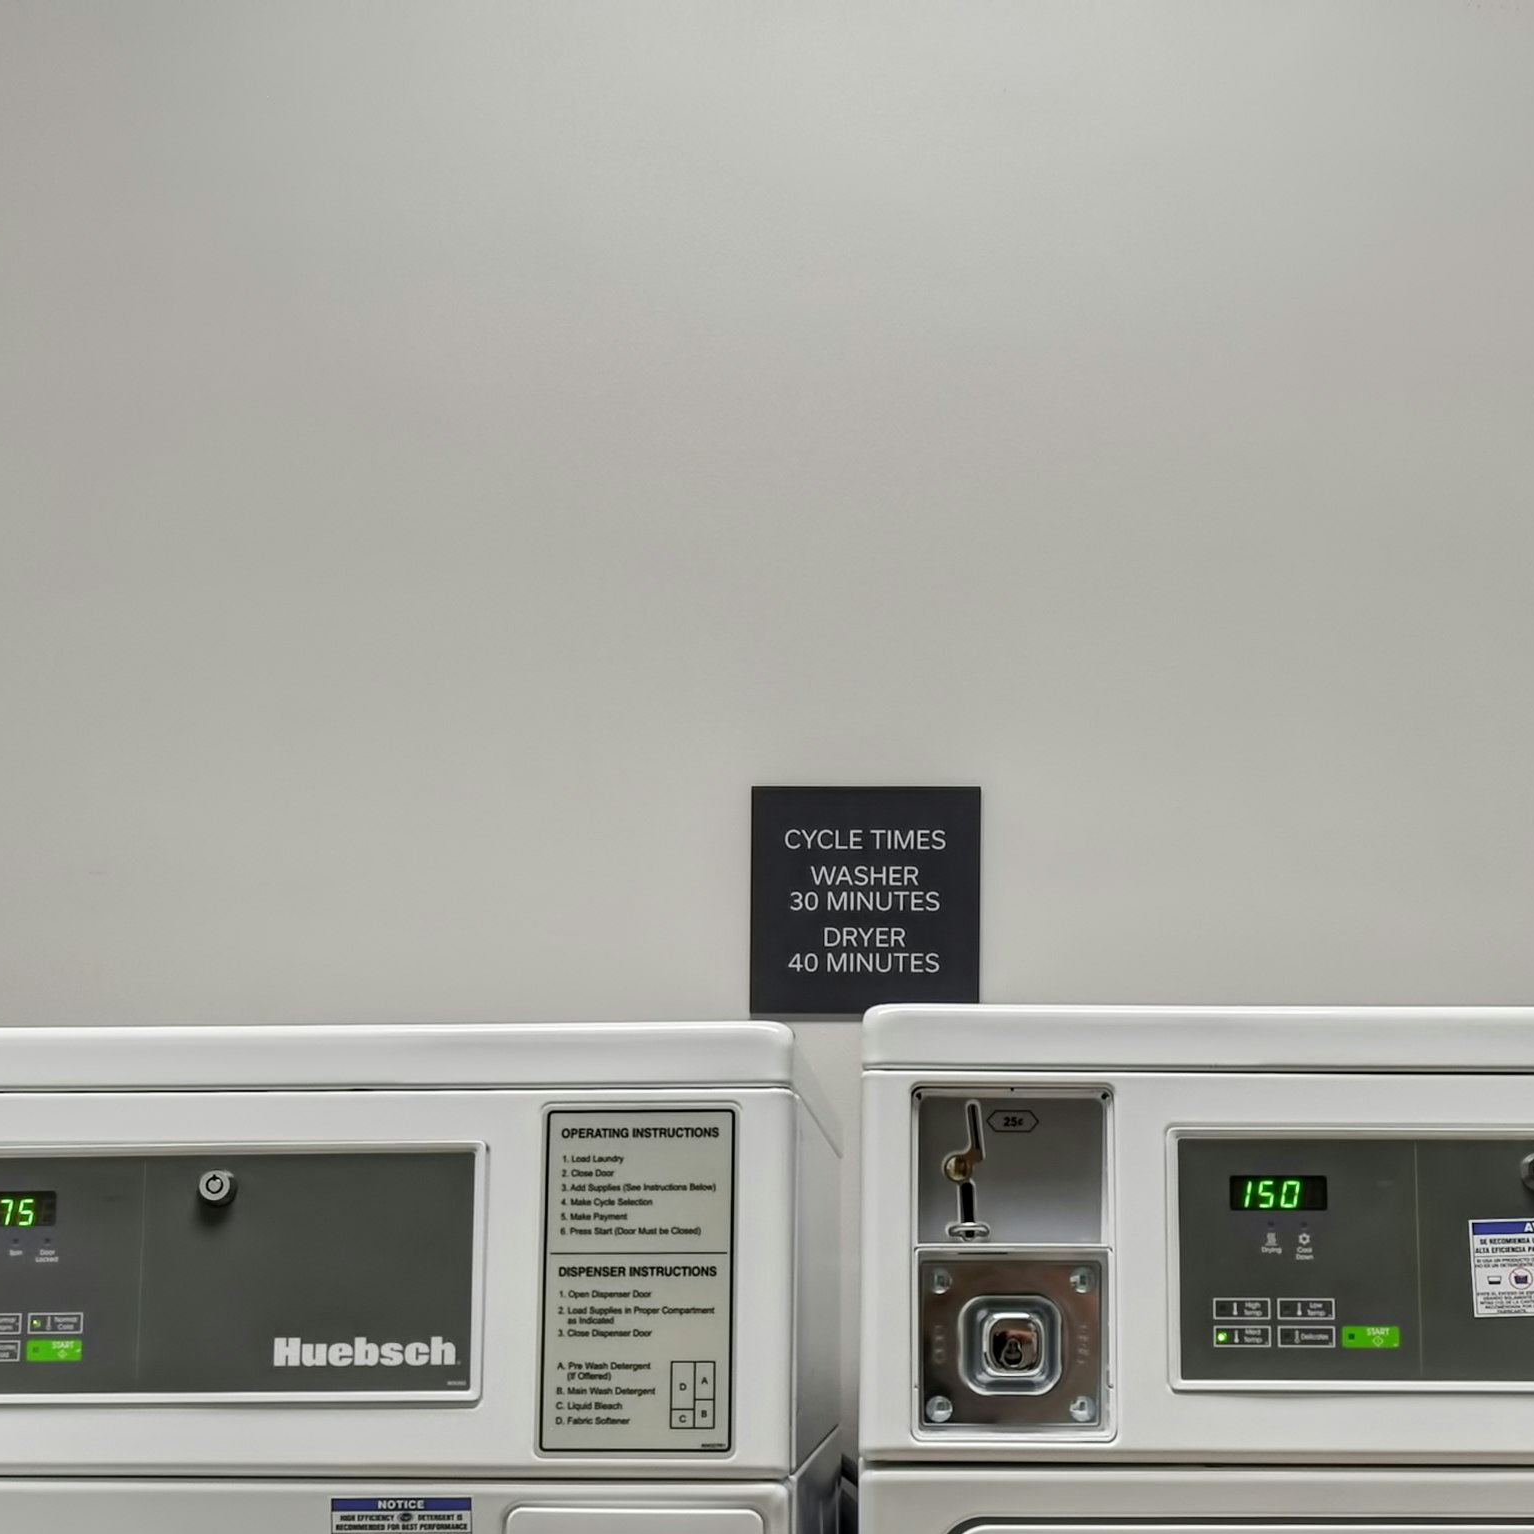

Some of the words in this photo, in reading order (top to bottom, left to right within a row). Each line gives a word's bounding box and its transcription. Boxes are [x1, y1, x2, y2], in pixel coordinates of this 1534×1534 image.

[784, 829, 863, 850] CYCLE
[871, 830, 946, 850] TIMES
[811, 866, 919, 885] WASHER
[790, 892, 818, 911] 30
[827, 892, 940, 911] MINUTES
[824, 928, 906, 947] DRYER
[788, 953, 818, 972] 40
[827, 953, 940, 973] MINUTES
[561, 1128, 629, 1138] OPERATING
[632, 1127, 719, 1138] INSTRUCTIONS
[571, 1155, 590, 1163] Load
[593, 1155, 624, 1164] Laundry
[571, 1169, 593, 1177] Close
[595, 1169, 614, 1177] Door
[588, 1184, 620, 1193] Supplies
[623, 1184, 641, 1192] (See
[690, 1183, 716, 1192] Below)
[1245, 1181, 1300, 1208] 150
[570, 1198, 591, 1206] Make
[594, 1198, 615, 1207] Cycle
[593, 1213, 627, 1222] Payment
[570, 1227, 591, 1235] Press
[594, 1227, 612, 1235] Start
[615, 1227, 636, 1235] (Door
[638, 1227, 657, 1235] Must
[659, 1227, 668, 1235] be
[671, 1227, 701, 1235] Closed)
[558, 1267, 626, 1277] DISPENSER
[629, 1266, 717, 1277] INSTRUCTIONS
[568, 1290, 589, 1299] Open
[592, 1290, 630, 1299] Dispenser
[633, 1290, 651, 1298] Door
[567, 1306, 587, 1314] Load
[590, 1306, 622, 1315] Supplies
[634, 1307, 660, 1315] Proper
[662, 1307, 715, 1315] Compartment
[567, 1329, 589, 1337] Close
[592, 1329, 630, 1338] Dispenser
[633, 1329, 652, 1337] Door
[273, 1336, 456, 1366] Huebsch
[585, 1362, 608, 1370] Wash
[611, 1362, 651, 1371] Detergent
[568, 1387, 587, 1395] Main
[590, 1387, 612, 1395] Wash
[615, 1387, 655, 1396] Detergent
[679, 1383, 687, 1391] D
[567, 1402, 592, 1410] Liquid
[595, 1402, 622, 1410] Bleach
[701, 1410, 707, 1418] B
[567, 1417, 592, 1425] Fabric
[595, 1417, 630, 1425] Softener
[679, 1415, 687, 1423] C
[378, 1500, 424, 1509] NOTICE
